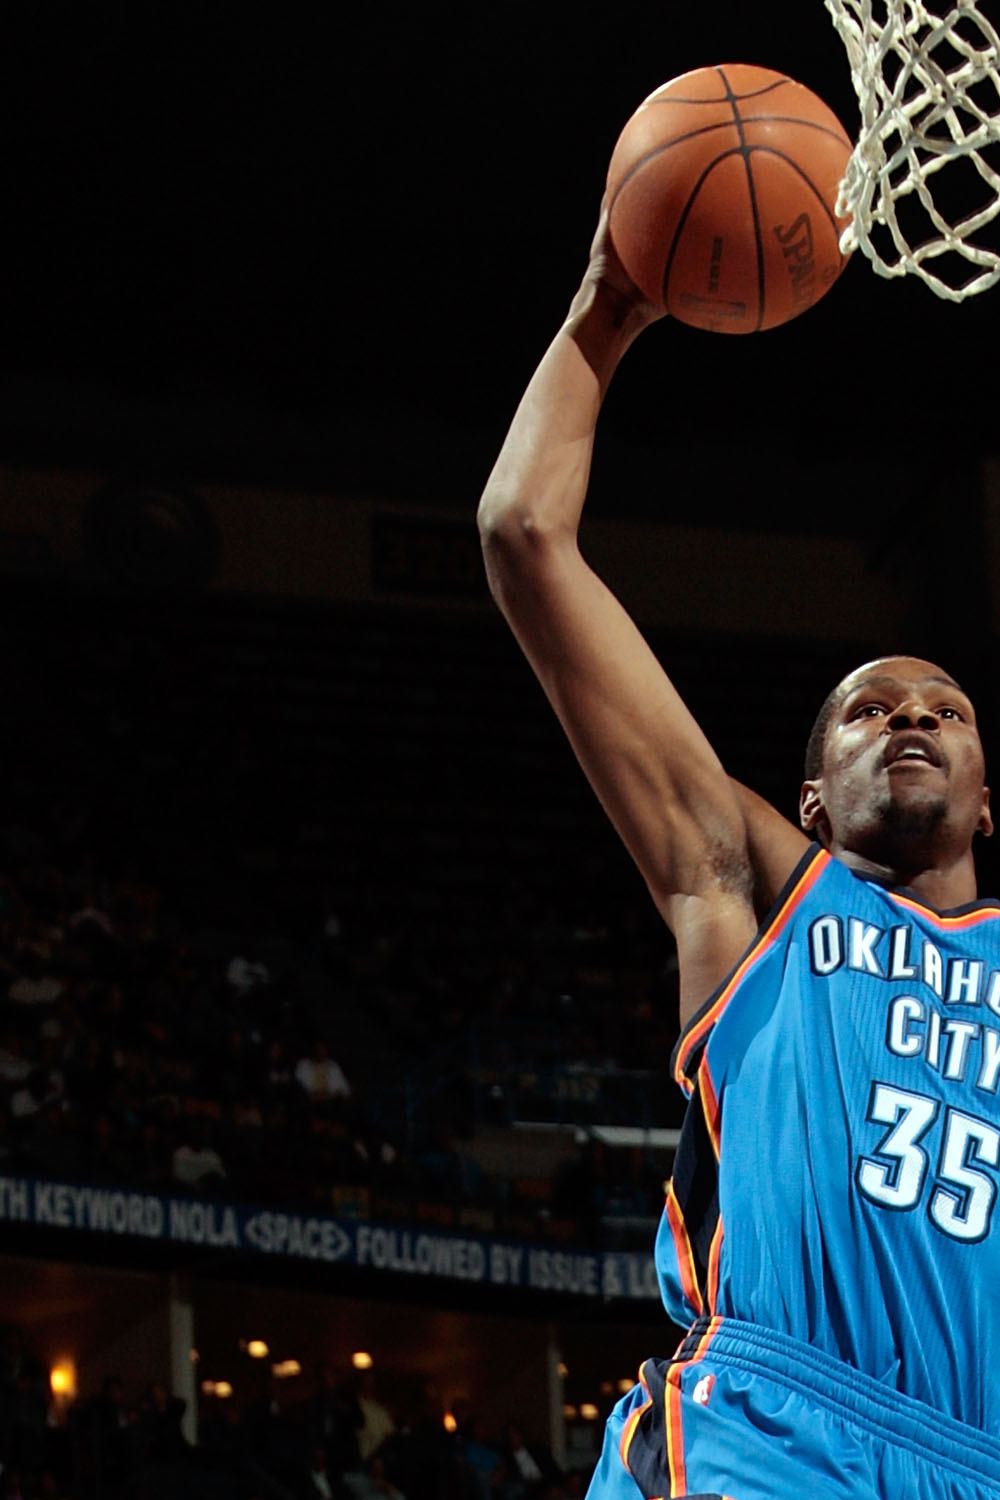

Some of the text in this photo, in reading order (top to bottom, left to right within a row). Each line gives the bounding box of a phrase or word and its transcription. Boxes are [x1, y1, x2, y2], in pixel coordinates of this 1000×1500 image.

[34, 1180, 164, 1239] KEYWORD
[169, 1197, 240, 1248] NOLA
[356, 1223, 486, 1282] FOLLOWED
[490, 1241, 523, 1285] BY
[528, 1247, 599, 1296] ISSUE
